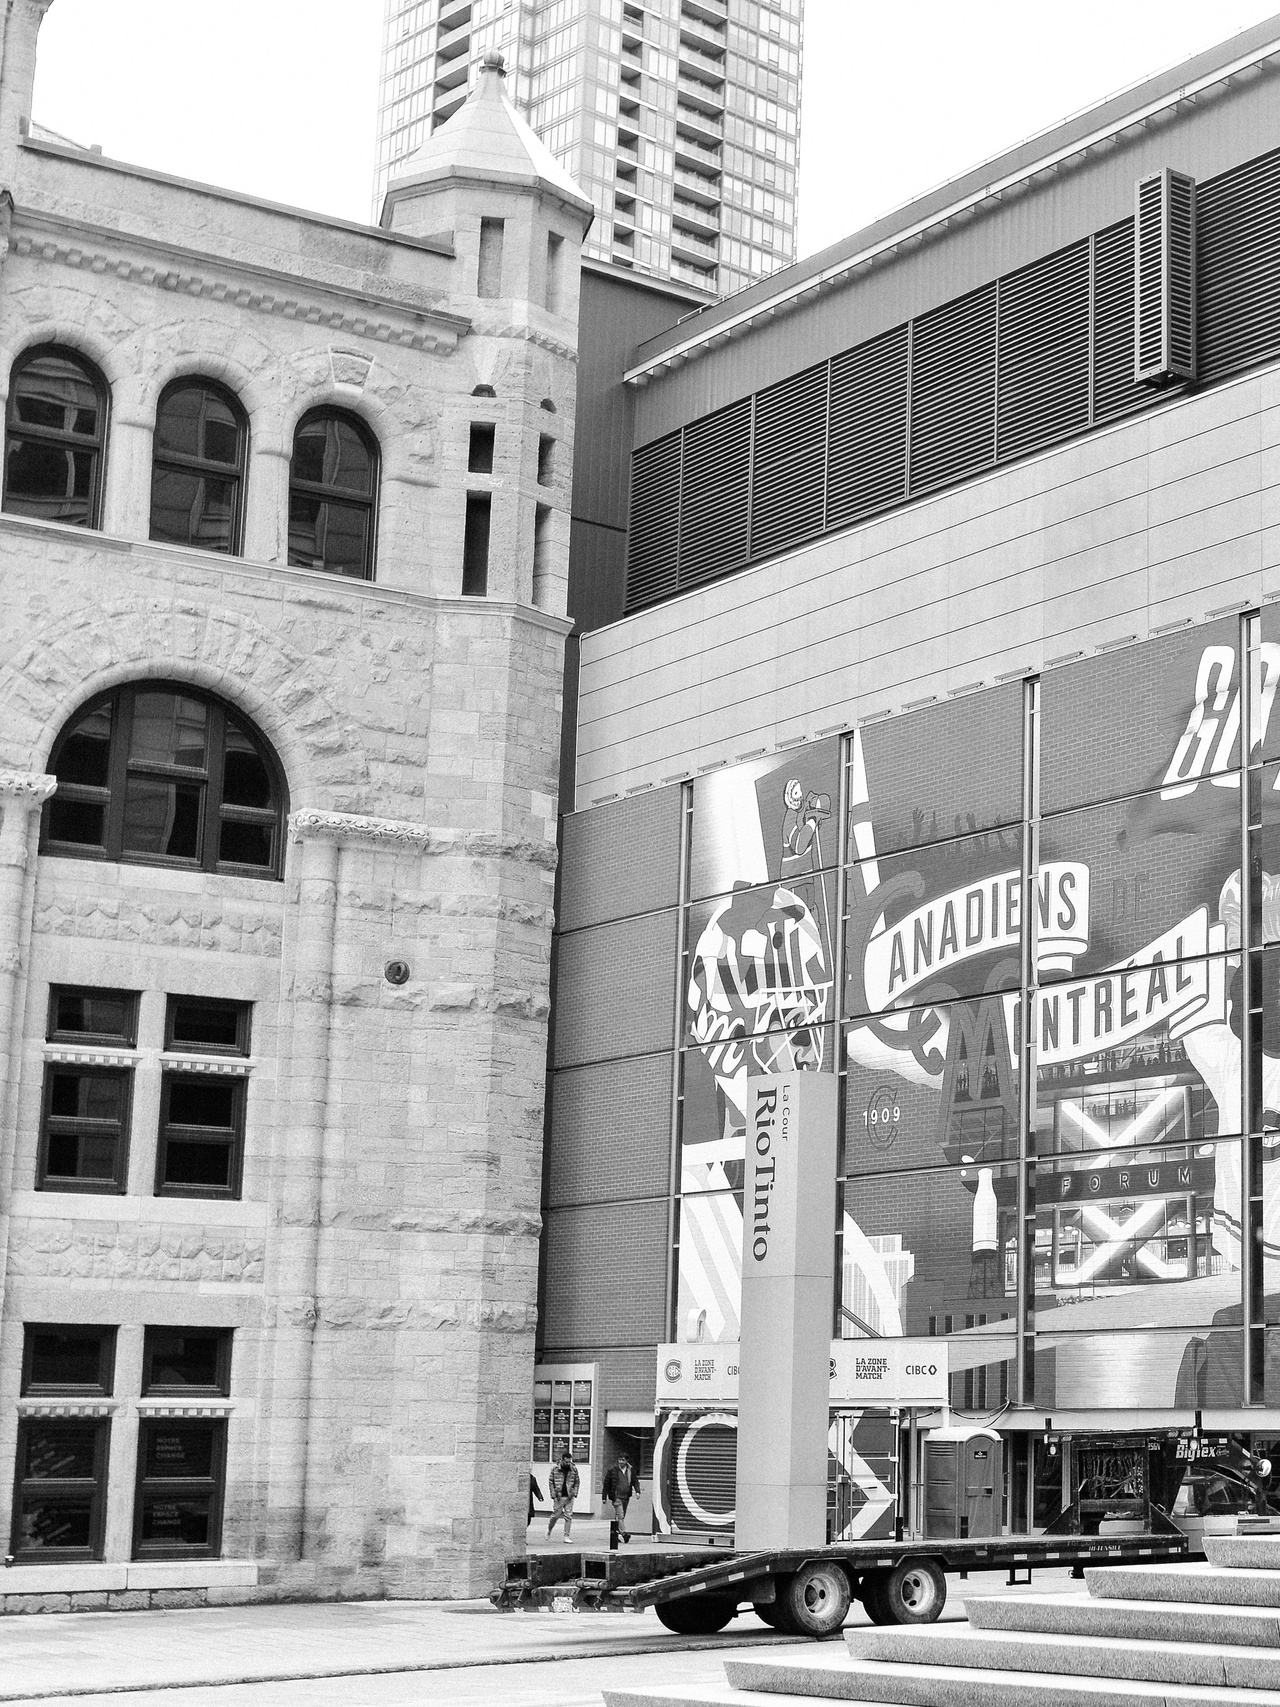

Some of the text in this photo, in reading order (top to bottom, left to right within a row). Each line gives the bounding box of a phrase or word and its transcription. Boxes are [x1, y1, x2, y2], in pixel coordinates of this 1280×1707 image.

[863, 1106, 901, 1126] 1909
[1062, 1165, 1191, 1195] FORUM
[855, 1372, 883, 1380] MATCH
[905, 1365, 927, 1375] CIBC
